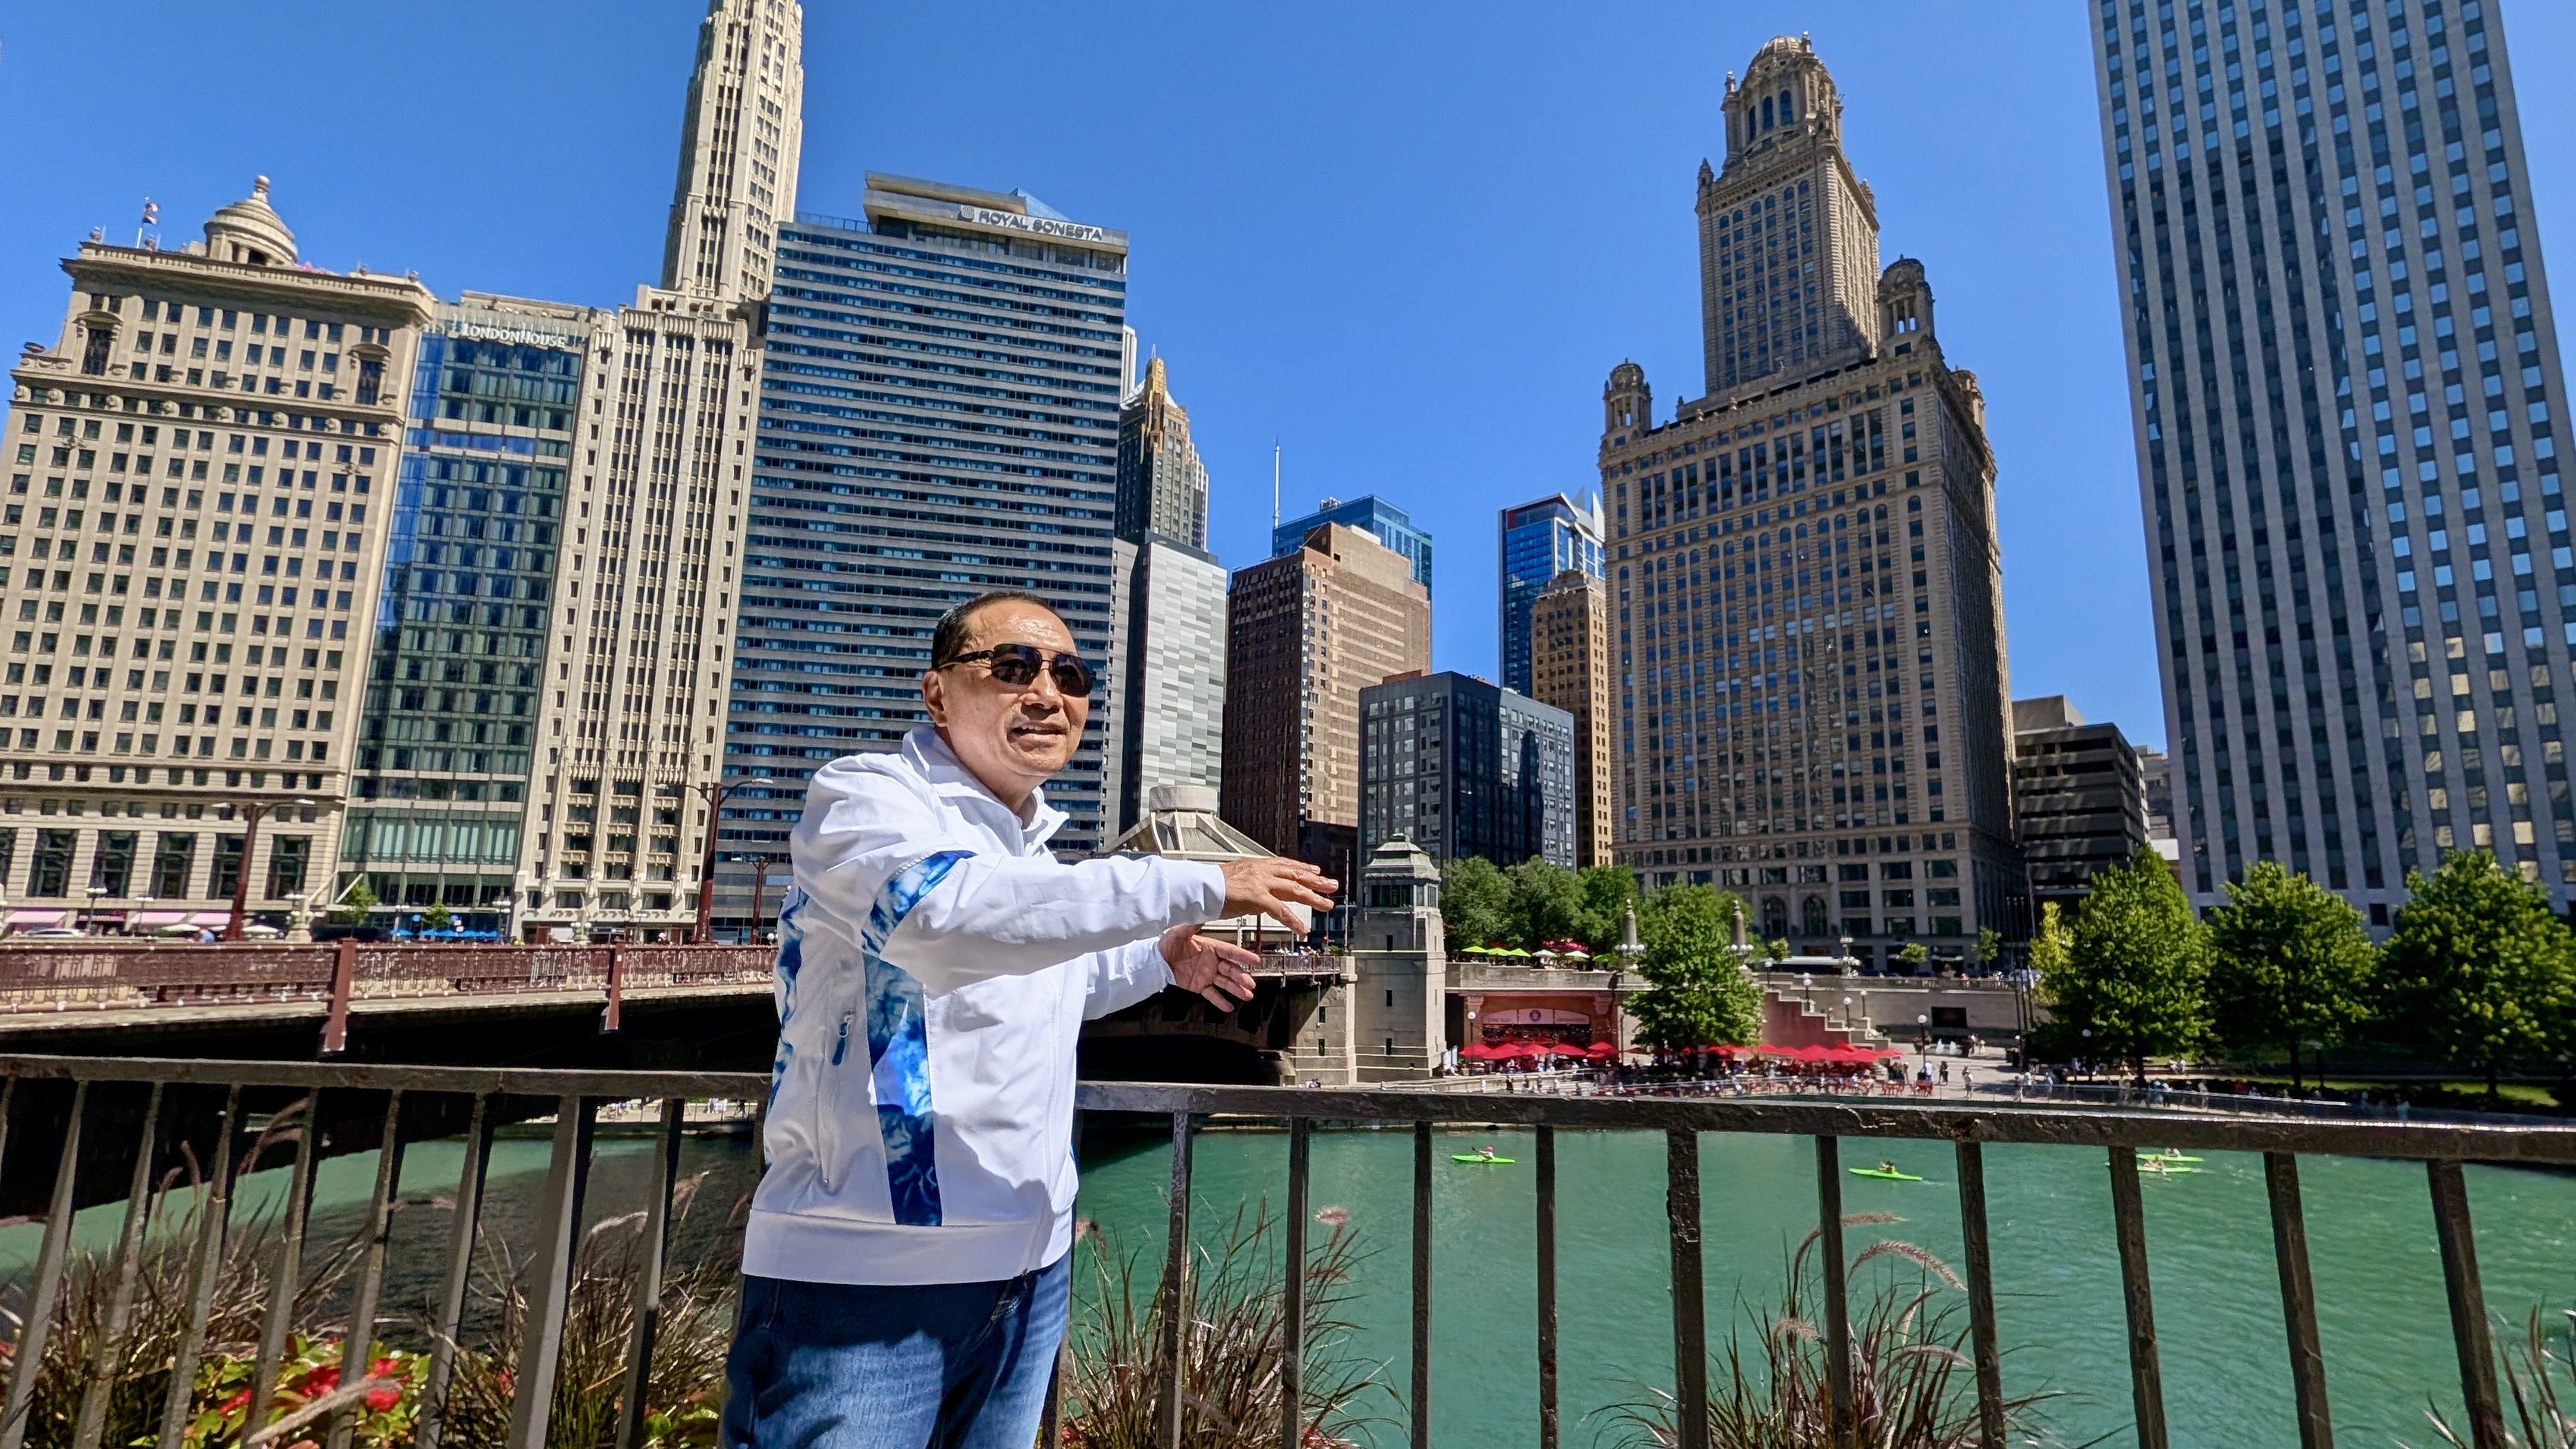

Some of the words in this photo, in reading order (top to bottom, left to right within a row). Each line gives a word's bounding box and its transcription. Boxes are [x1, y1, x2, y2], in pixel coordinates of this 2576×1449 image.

[979, 210, 1028, 229] ROYAL
[1032, 219, 1102, 241] SONESTA
[462, 323, 566, 349] LONDONHOUSE
